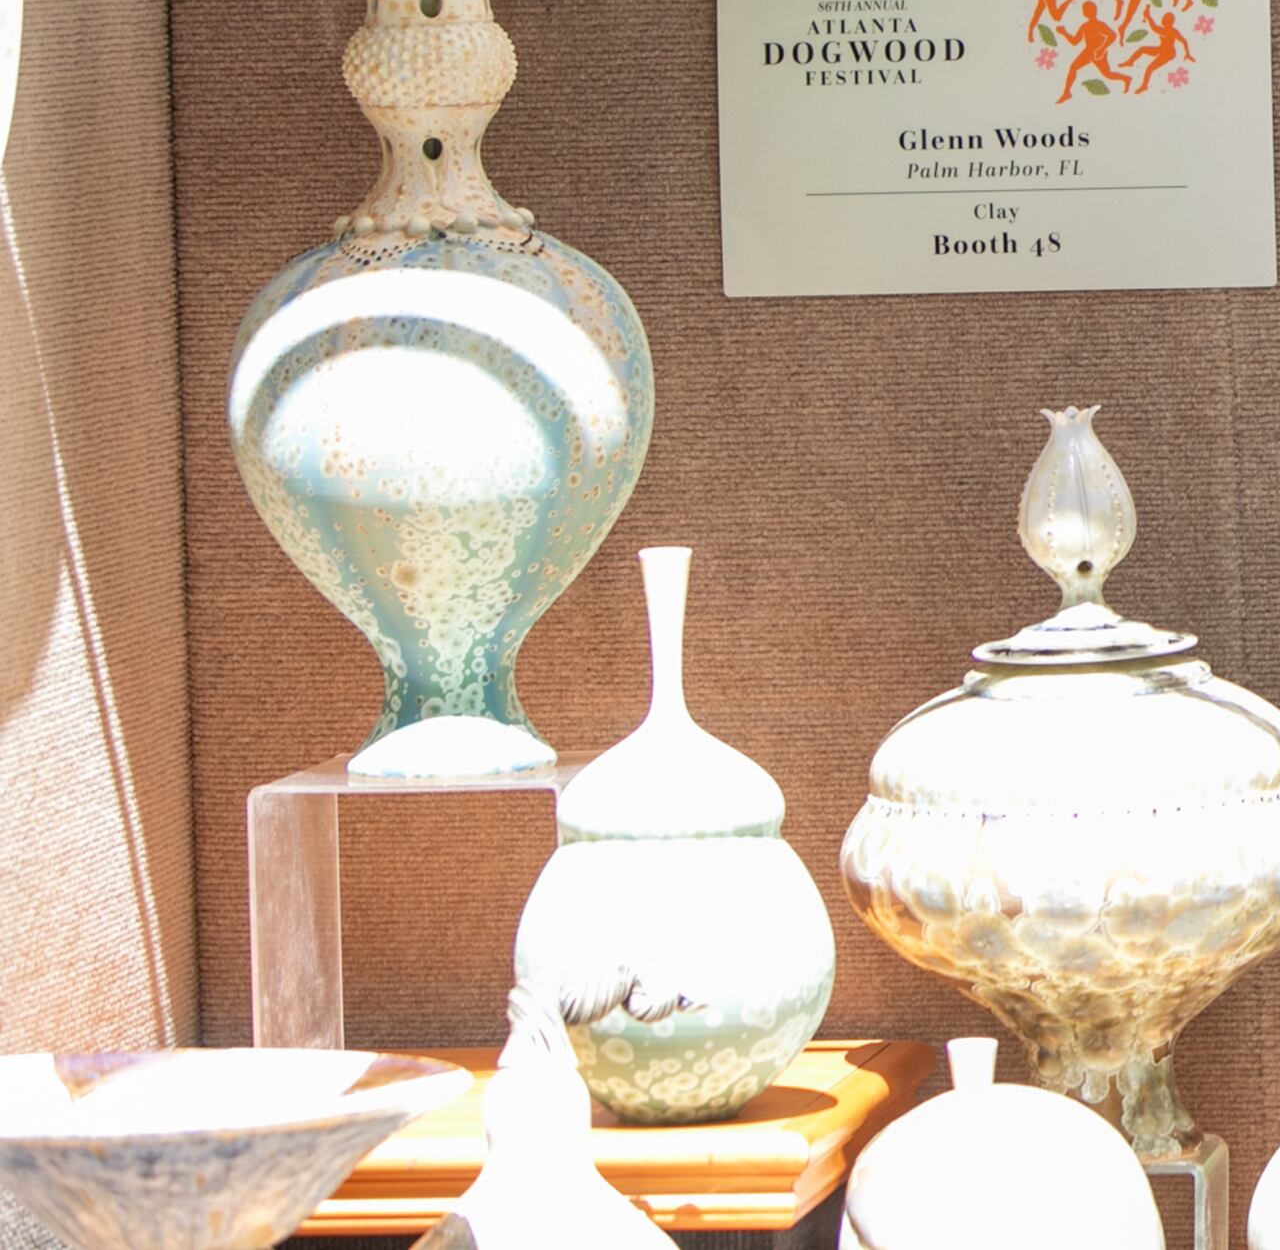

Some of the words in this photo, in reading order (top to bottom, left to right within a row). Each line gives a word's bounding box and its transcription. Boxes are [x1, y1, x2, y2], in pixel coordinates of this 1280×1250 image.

[818, 0, 852, 13] 86TH
[853, 0, 906, 12] ANNUAL
[807, 16, 919, 36] ATLANTA
[762, 32, 967, 66] DOGWOOD
[804, 67, 923, 87] FESTIVAL
[898, 128, 985, 152] Glenn
[993, 125, 1091, 149] Woods
[906, 161, 960, 180] Palm
[967, 159, 1050, 179] Harbor,
[1058, 159, 1084, 177] FL
[973, 202, 1021, 224] Clay
[932, 231, 1018, 256] Booth
[1029, 231, 1062, 258] 48
